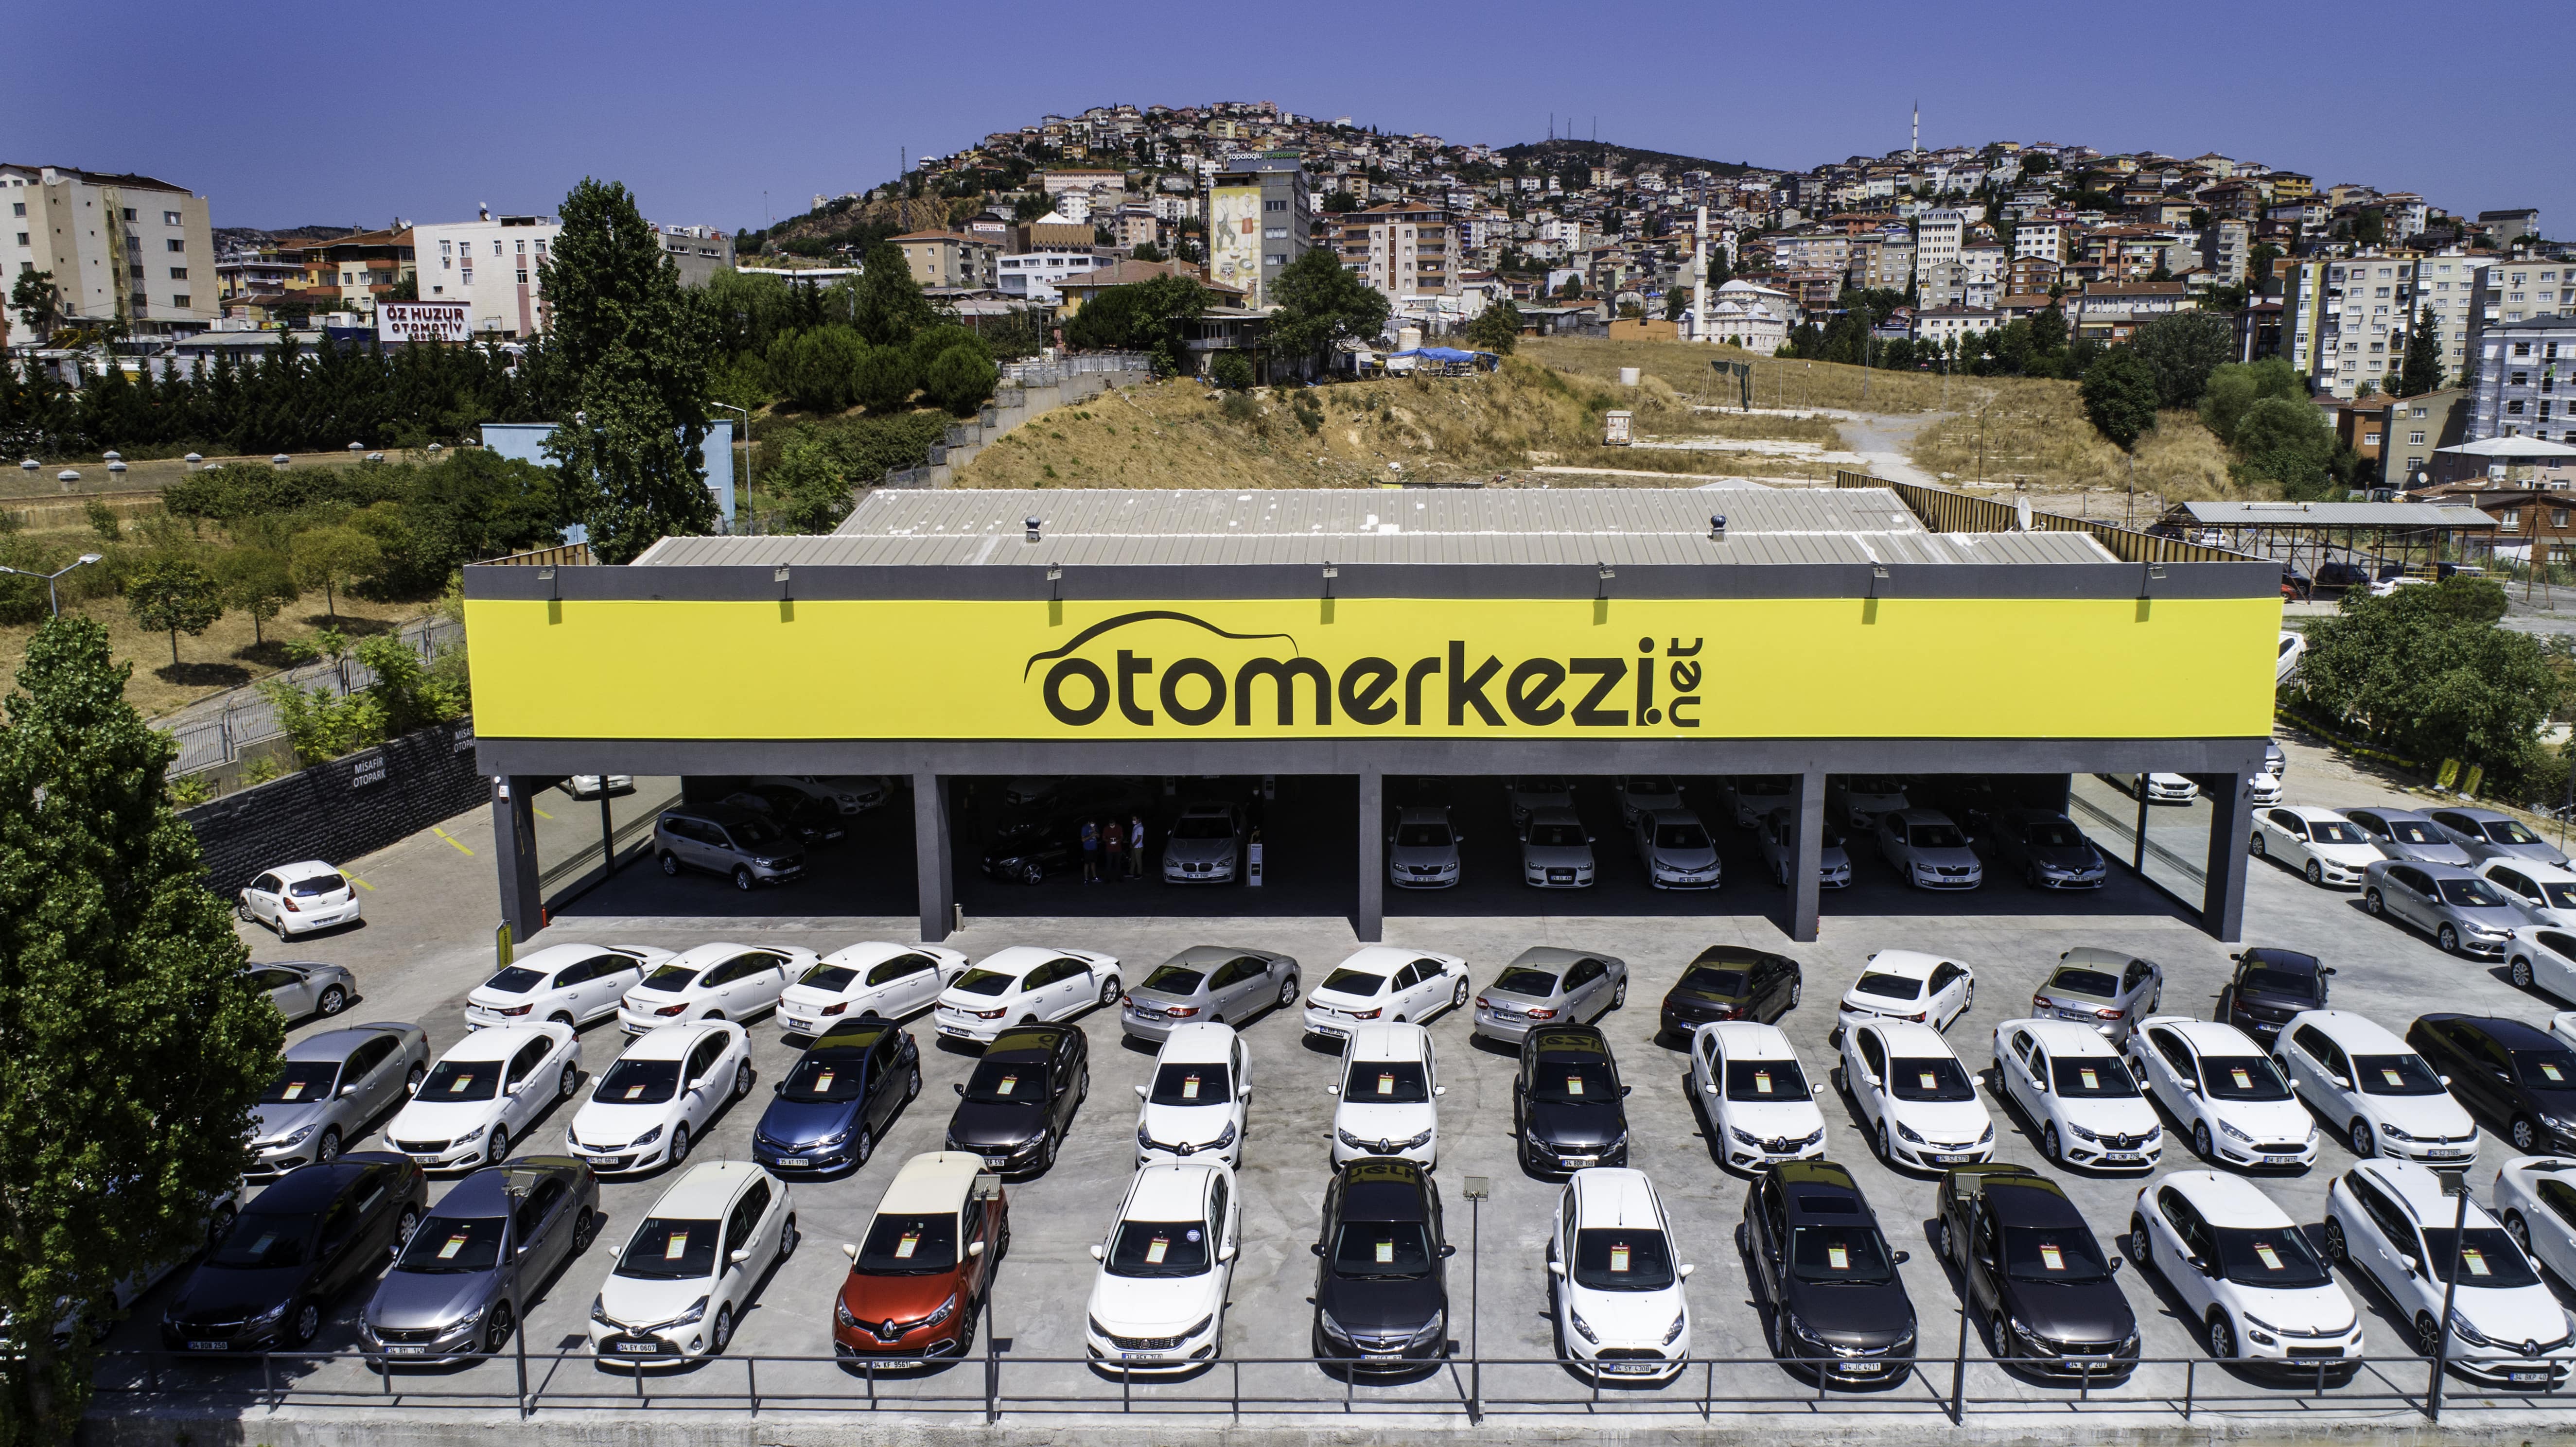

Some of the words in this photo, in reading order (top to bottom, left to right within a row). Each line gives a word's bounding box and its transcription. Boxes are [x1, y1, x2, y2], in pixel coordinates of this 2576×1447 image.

[386, 304, 407, 321] ÖZ
[411, 308, 465, 321] HUZUR
[392, 320, 462, 333] OTOMOTİV
[355, 756, 383, 774] MİSAFİR
[353, 768, 386, 787] OTOPARK
